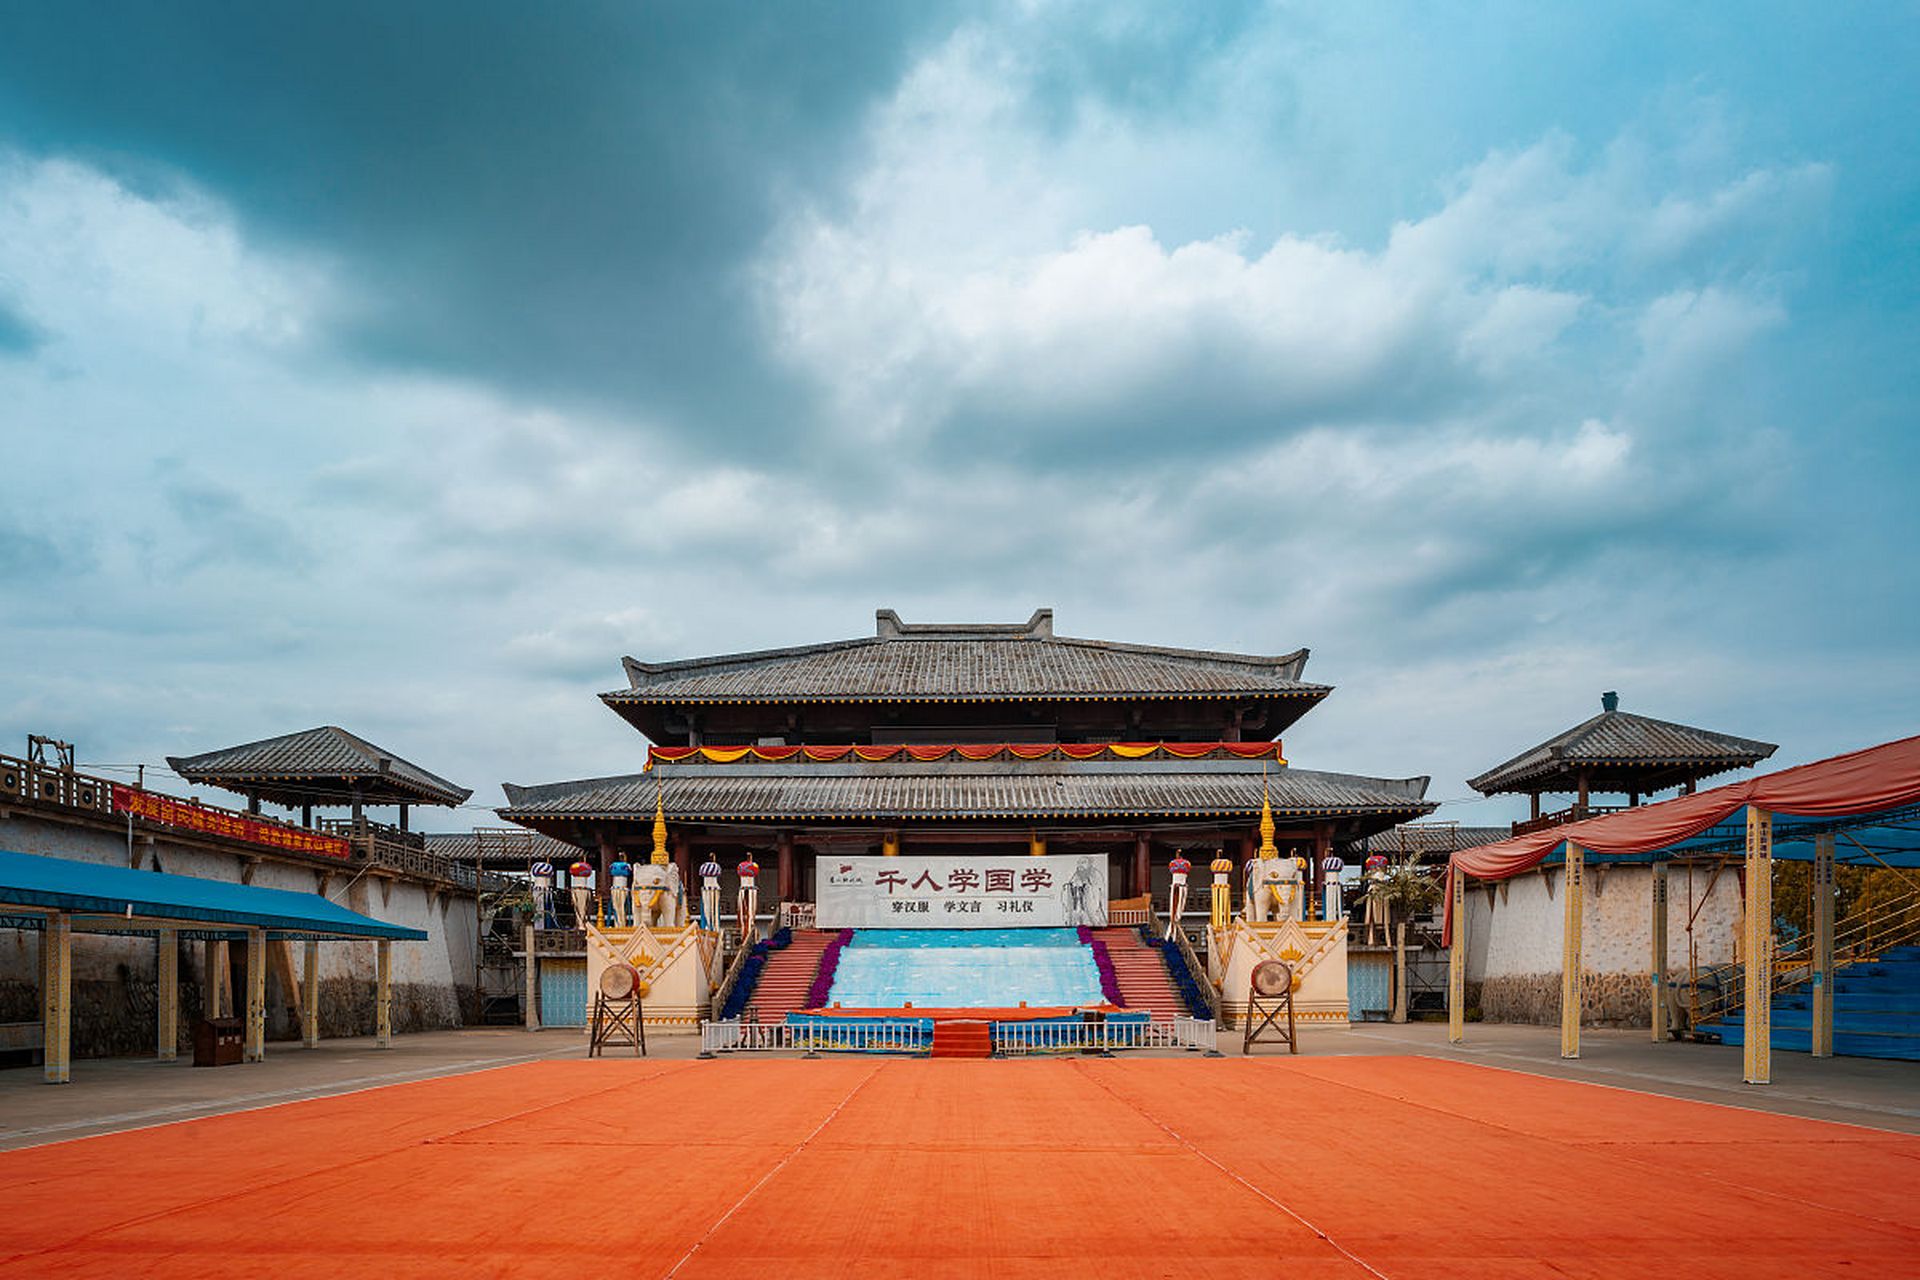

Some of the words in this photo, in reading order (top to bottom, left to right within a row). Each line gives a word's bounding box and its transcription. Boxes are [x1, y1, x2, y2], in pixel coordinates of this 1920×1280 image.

[875, 868, 1053, 894] 千人学国学
[891, 900, 930, 913] 穿汉服
[943, 900, 982, 913] 学文言
[997, 900, 1034, 913] 习礼仪
